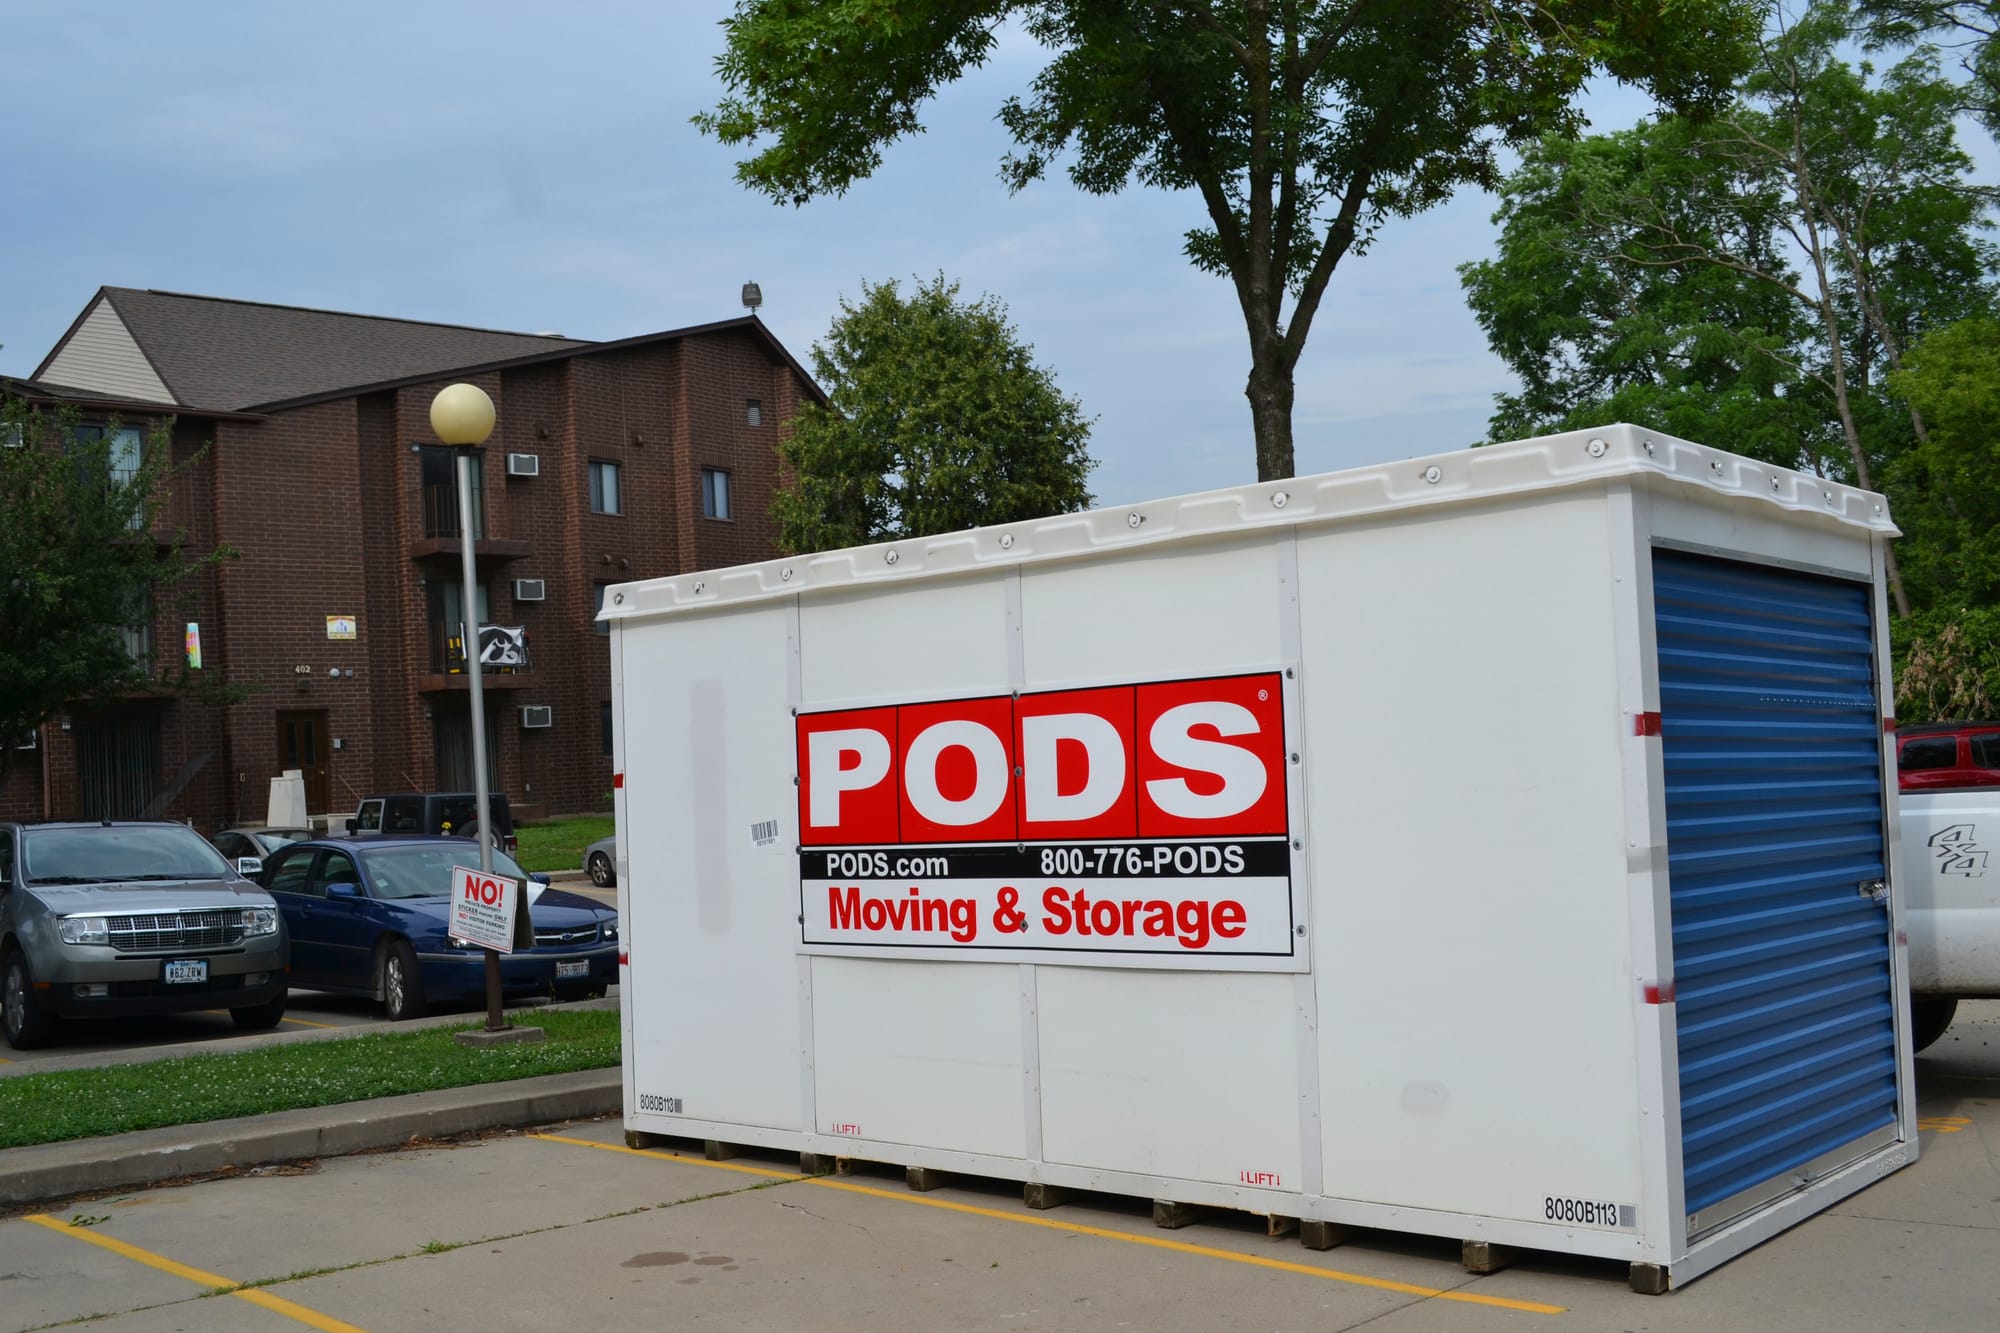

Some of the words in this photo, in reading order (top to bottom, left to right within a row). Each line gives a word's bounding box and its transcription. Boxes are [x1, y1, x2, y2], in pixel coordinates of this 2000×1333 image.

[295, 665, 311, 674] 402
[808, 701, 1267, 827] PODS
[827, 851, 949, 878] PODS.com
[1041, 845, 1246, 876] 800-776-PODS
[465, 875, 504, 909] NO!
[458, 904, 478, 914] STICKER
[494, 914, 507, 922] ONLY
[828, 886, 977, 943] Moving
[993, 886, 1028, 934] &
[1041, 886, 1247, 949] Storage
[468, 916, 485, 924] VISITOR
[486, 920, 505, 930] PARKING
[640, 1094, 674, 1113] 8080B113
[836, 1123, 856, 1136] LIFT
[1247, 1171, 1274, 1186] LIFT
[1545, 1196, 1617, 1226] 8080B113
